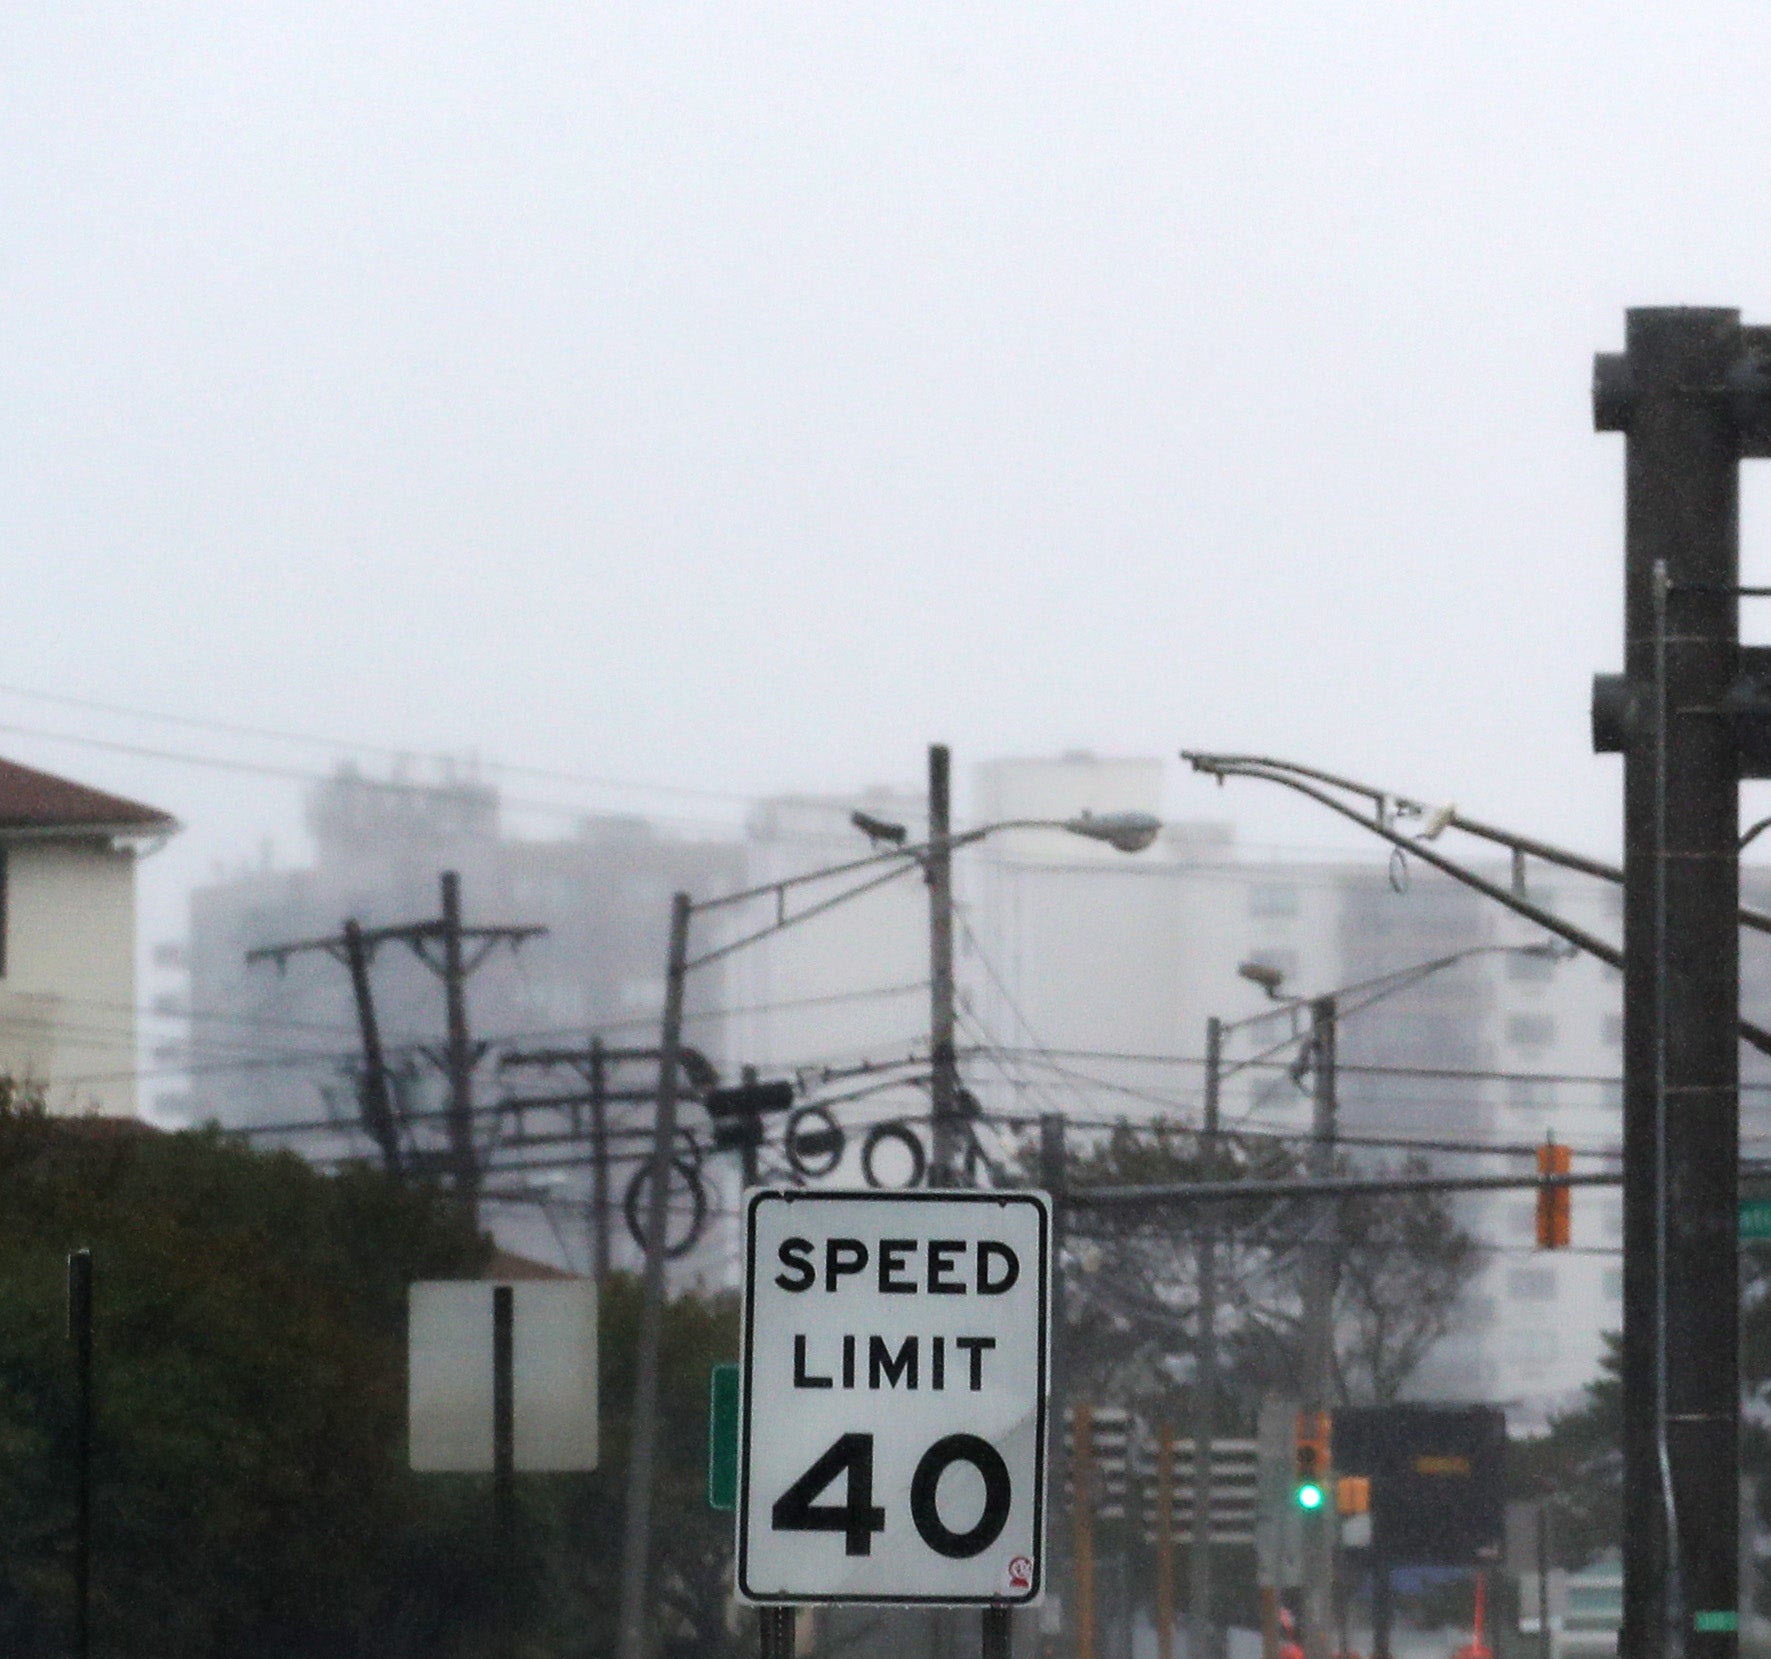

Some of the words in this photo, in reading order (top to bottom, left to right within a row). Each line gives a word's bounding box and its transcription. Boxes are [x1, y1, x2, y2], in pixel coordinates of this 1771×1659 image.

[774, 1237, 1020, 1295] SPEED
[793, 1334, 996, 1391] LIMIT
[771, 1432, 1012, 1559] 40
